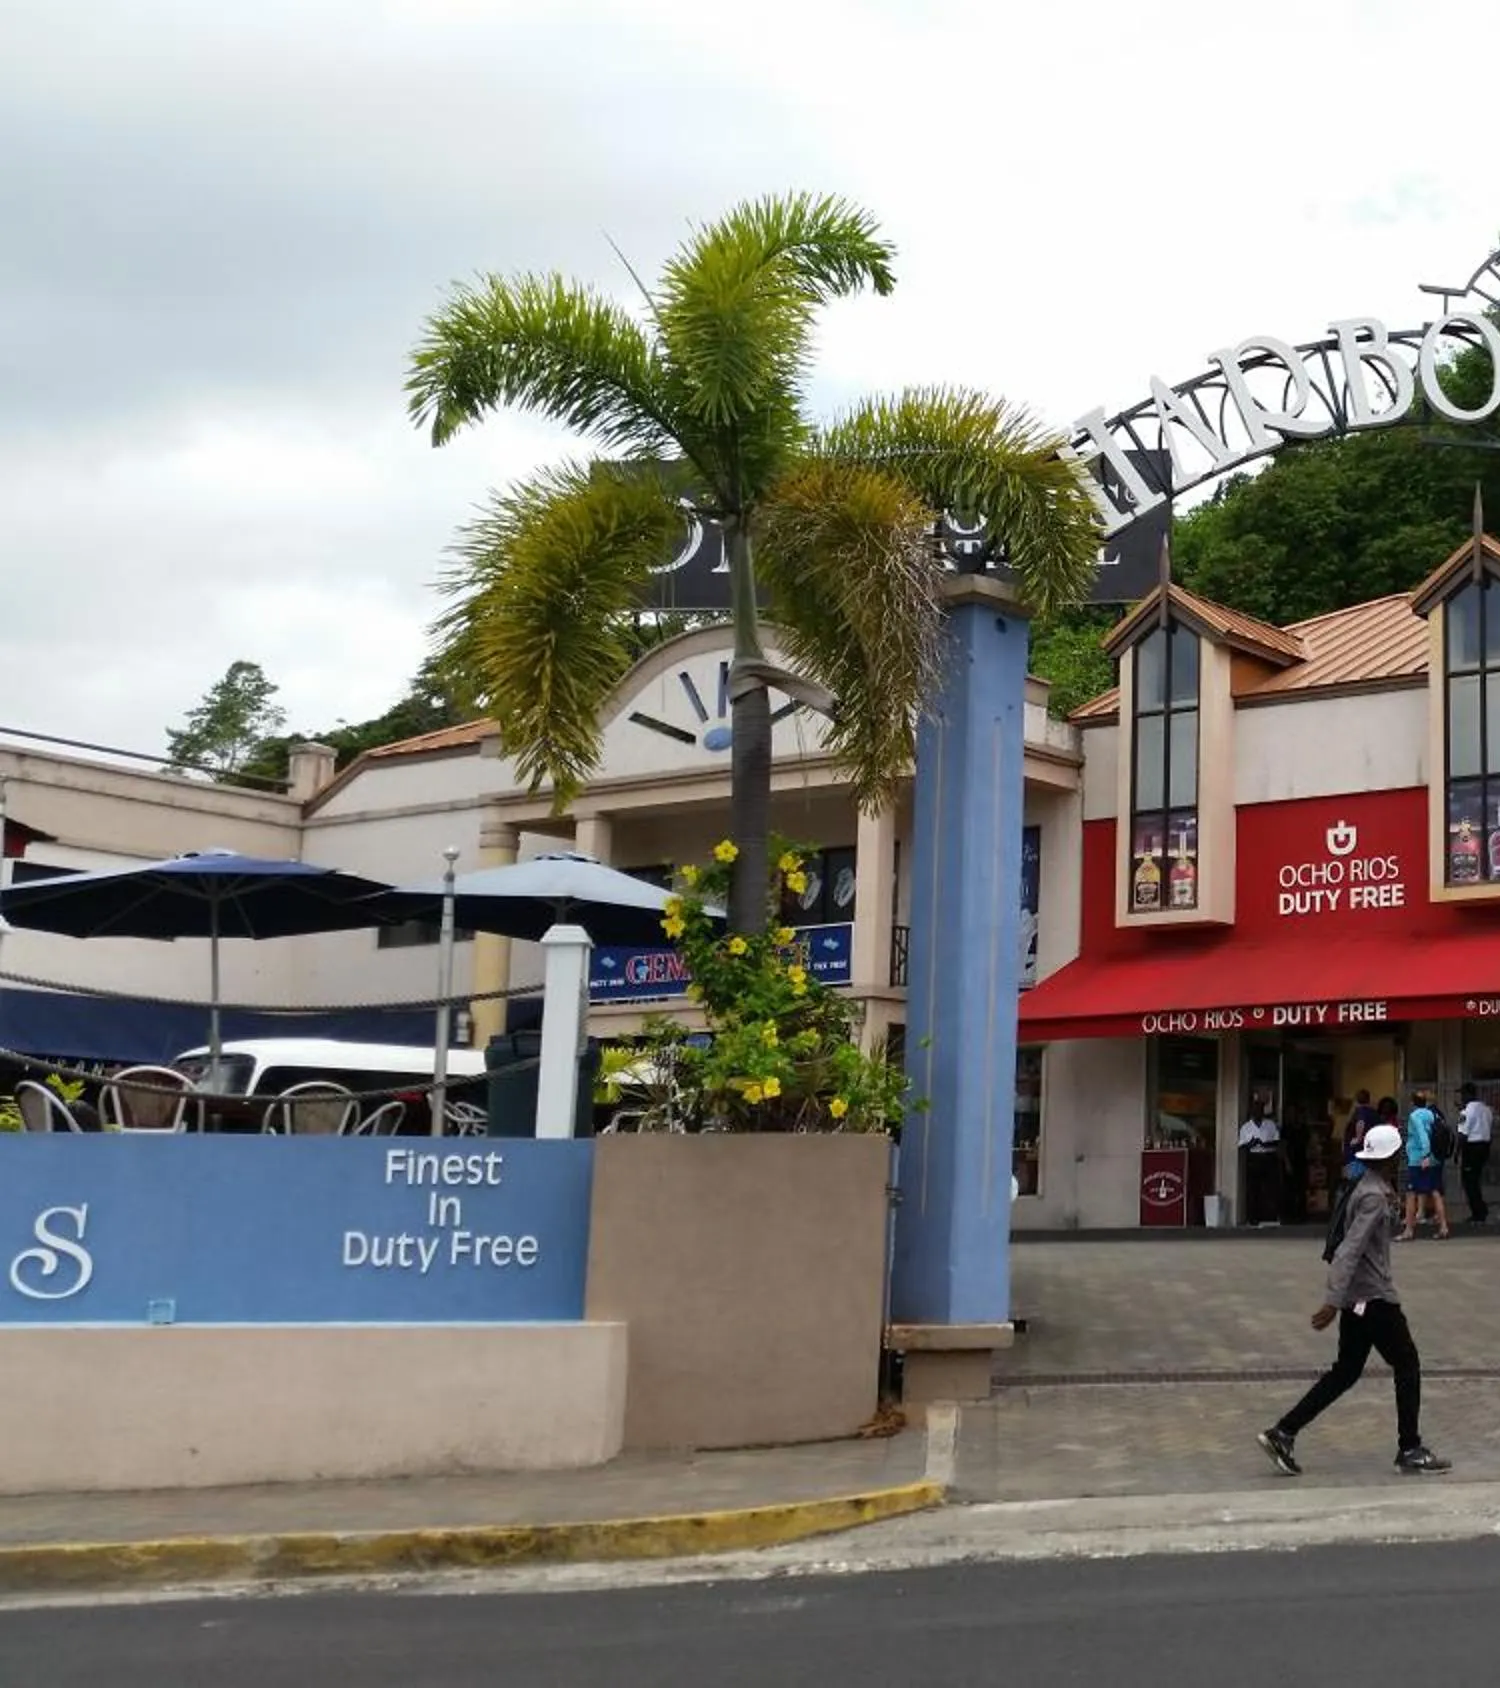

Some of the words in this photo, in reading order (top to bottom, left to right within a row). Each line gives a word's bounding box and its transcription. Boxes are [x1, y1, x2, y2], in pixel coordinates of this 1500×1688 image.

[1279, 861, 1344, 888] OCHO
[1350, 855, 1399, 882] RIOS
[1279, 889, 1341, 915] DUTY
[1349, 883, 1405, 909] FREE
[1142, 1012, 1197, 1034] OCHO
[1205, 1008, 1245, 1029] RIOS
[1272, 1005, 1329, 1026] DUTY
[1338, 1001, 1388, 1022] FREE
[385, 1149, 503, 1186] Finest
[428, 1191, 462, 1227] In
[10, 1202, 94, 1300] S
[342, 1230, 440, 1274] Duty
[450, 1231, 539, 1266] Free
